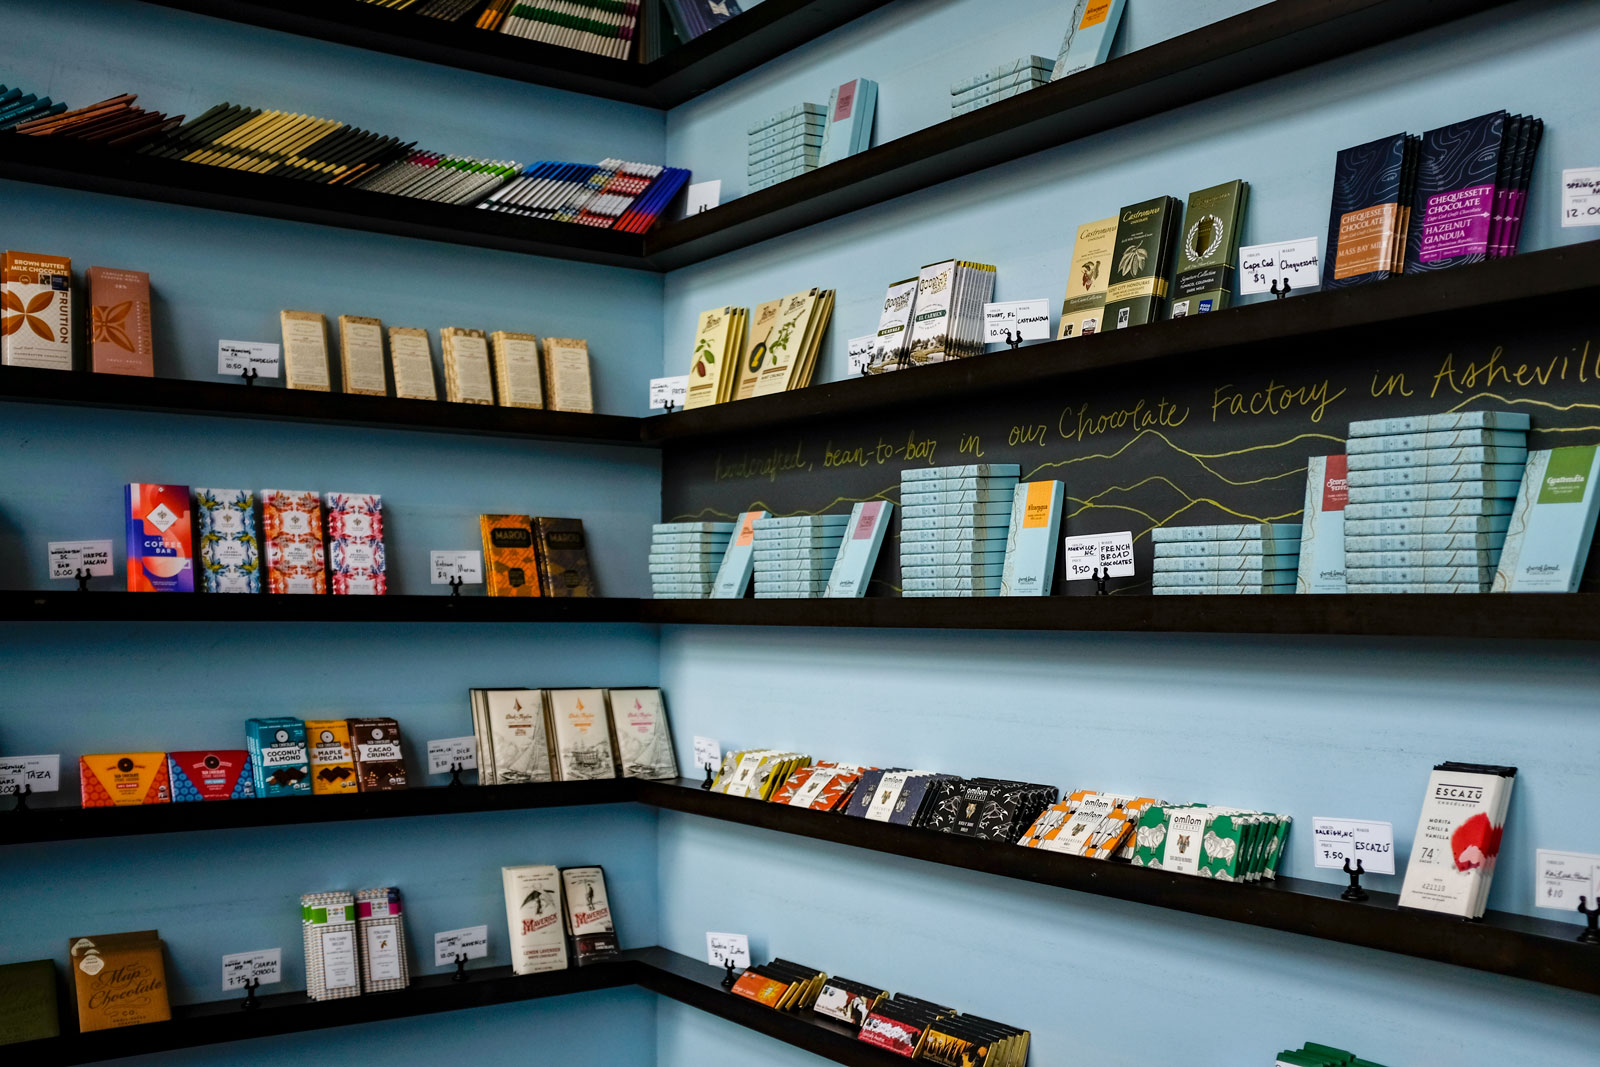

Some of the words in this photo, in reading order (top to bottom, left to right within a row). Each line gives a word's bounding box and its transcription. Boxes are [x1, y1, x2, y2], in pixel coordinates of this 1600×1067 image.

[1429, 187, 1492, 205] CHEQUESSETT
[1428, 198, 1481, 215] CHOCOLATE
[1342, 207, 1394, 224] CHEQUESSETT
[1341, 217, 1384, 233] CHOCOLATE
[1425, 219, 1472, 235] HAZELNUT
[1424, 230, 1465, 244] GIANDUJA
[14, 259, 40, 267] BROWN
[41, 262, 65, 270] BUTTER
[1243, 261, 1261, 271] Cape
[1262, 258, 1274, 267] Cod
[29, 267, 68, 276] CHOCOLATE
[59, 291, 69, 344] FRUITION
[990, 328, 1010, 336] 10.00
[823, 430, 937, 467] bean-to-bar
[960, 433, 985, 458] in
[1008, 424, 1048, 447] our
[1058, 397, 1190, 442] Chocolate
[1212, 380, 1347, 422] Factory
[1371, 369, 1414, 397] in
[495, 530, 527, 541] MAROU
[1101, 543, 1130, 552] FRENCH
[1100, 551, 1130, 561] BROAD
[267, 749, 301, 757] COCONUT
[26, 770, 51, 779] TAZA
[1324, 850, 1344, 860] 7.50
[1422, 847, 1434, 859] 74
[522, 913, 557, 936] MAVERICK
[575, 908, 608, 928] MAVERICK
[254, 960, 277, 969] CHARM
[104, 965, 141, 988] Map
[88, 977, 162, 1010] Chocolate
